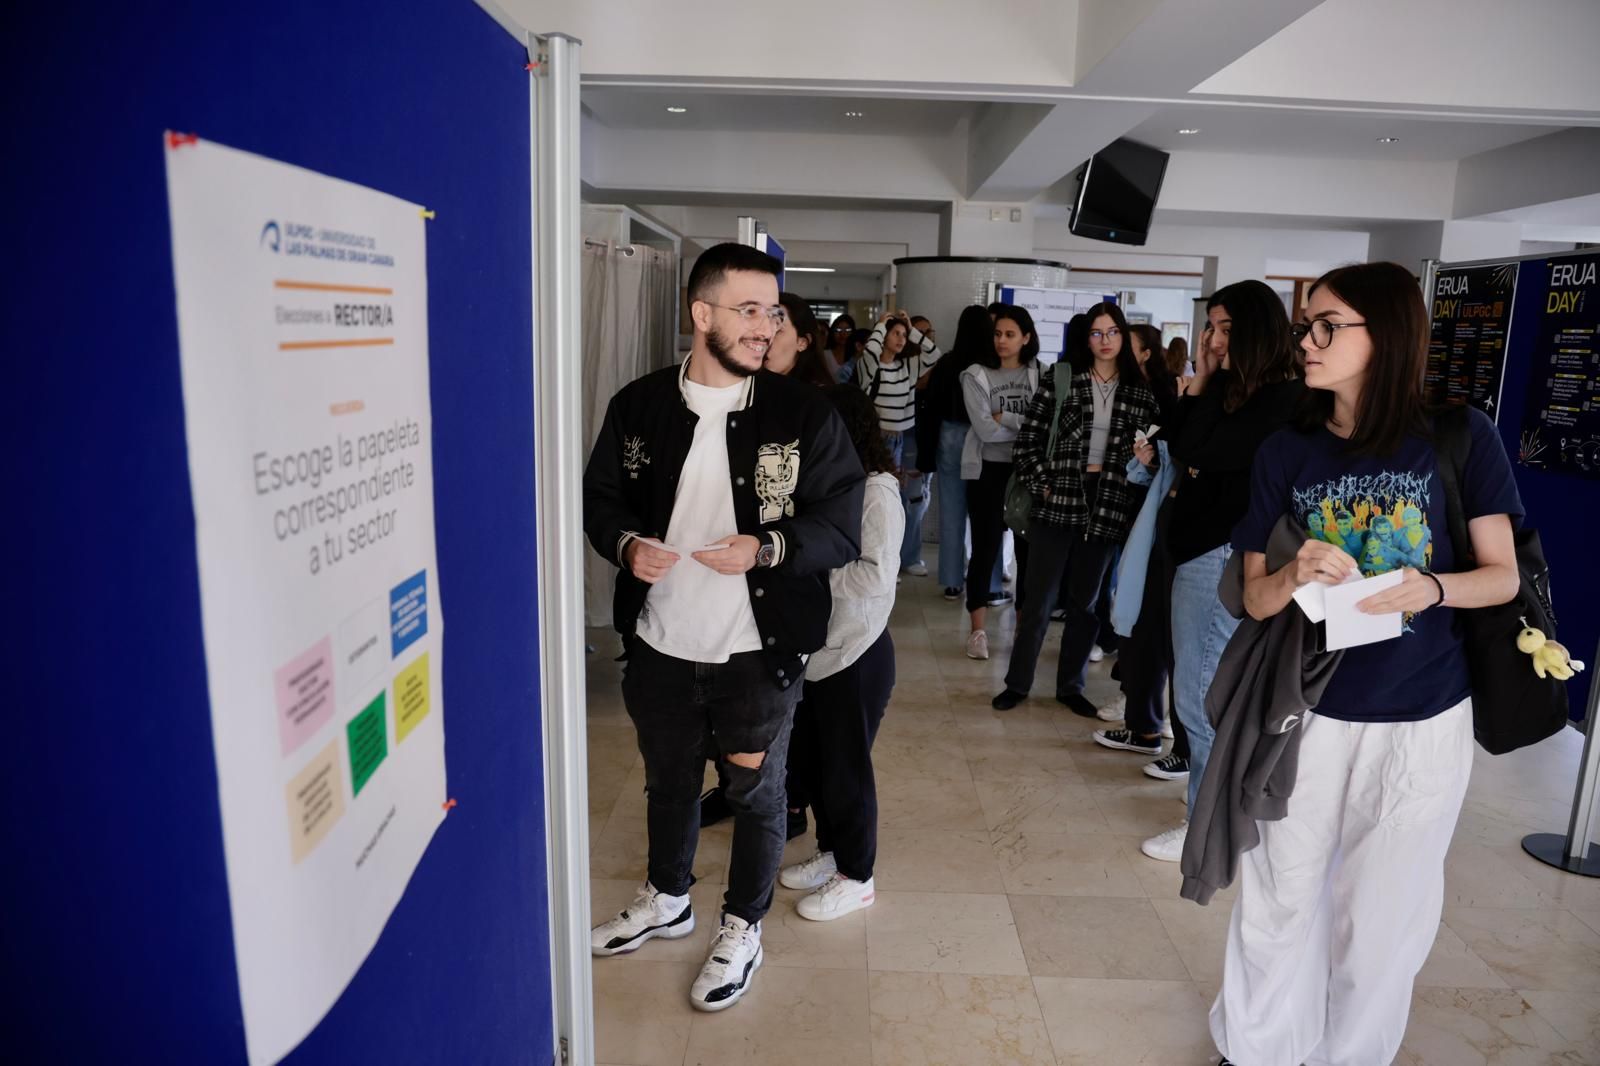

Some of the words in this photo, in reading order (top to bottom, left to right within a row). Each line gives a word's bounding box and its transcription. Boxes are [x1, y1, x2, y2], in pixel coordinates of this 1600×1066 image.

[1436, 275, 1469, 296] ERUA
[1551, 262, 1597, 287] ERUA
[1433, 298, 1459, 319] DAY
[1462, 304, 1492, 318] ULPGC
[1546, 290, 1580, 314] DAY
[334, 303, 394, 328] RECTOR/A
[253, 444, 333, 495] Escoge
[337, 432, 353, 469] la
[357, 416, 420, 472] papeleta
[273, 459, 414, 541] correspondiente
[309, 545, 321, 576] a
[325, 529, 343, 566] tu
[347, 507, 398, 555] sector
